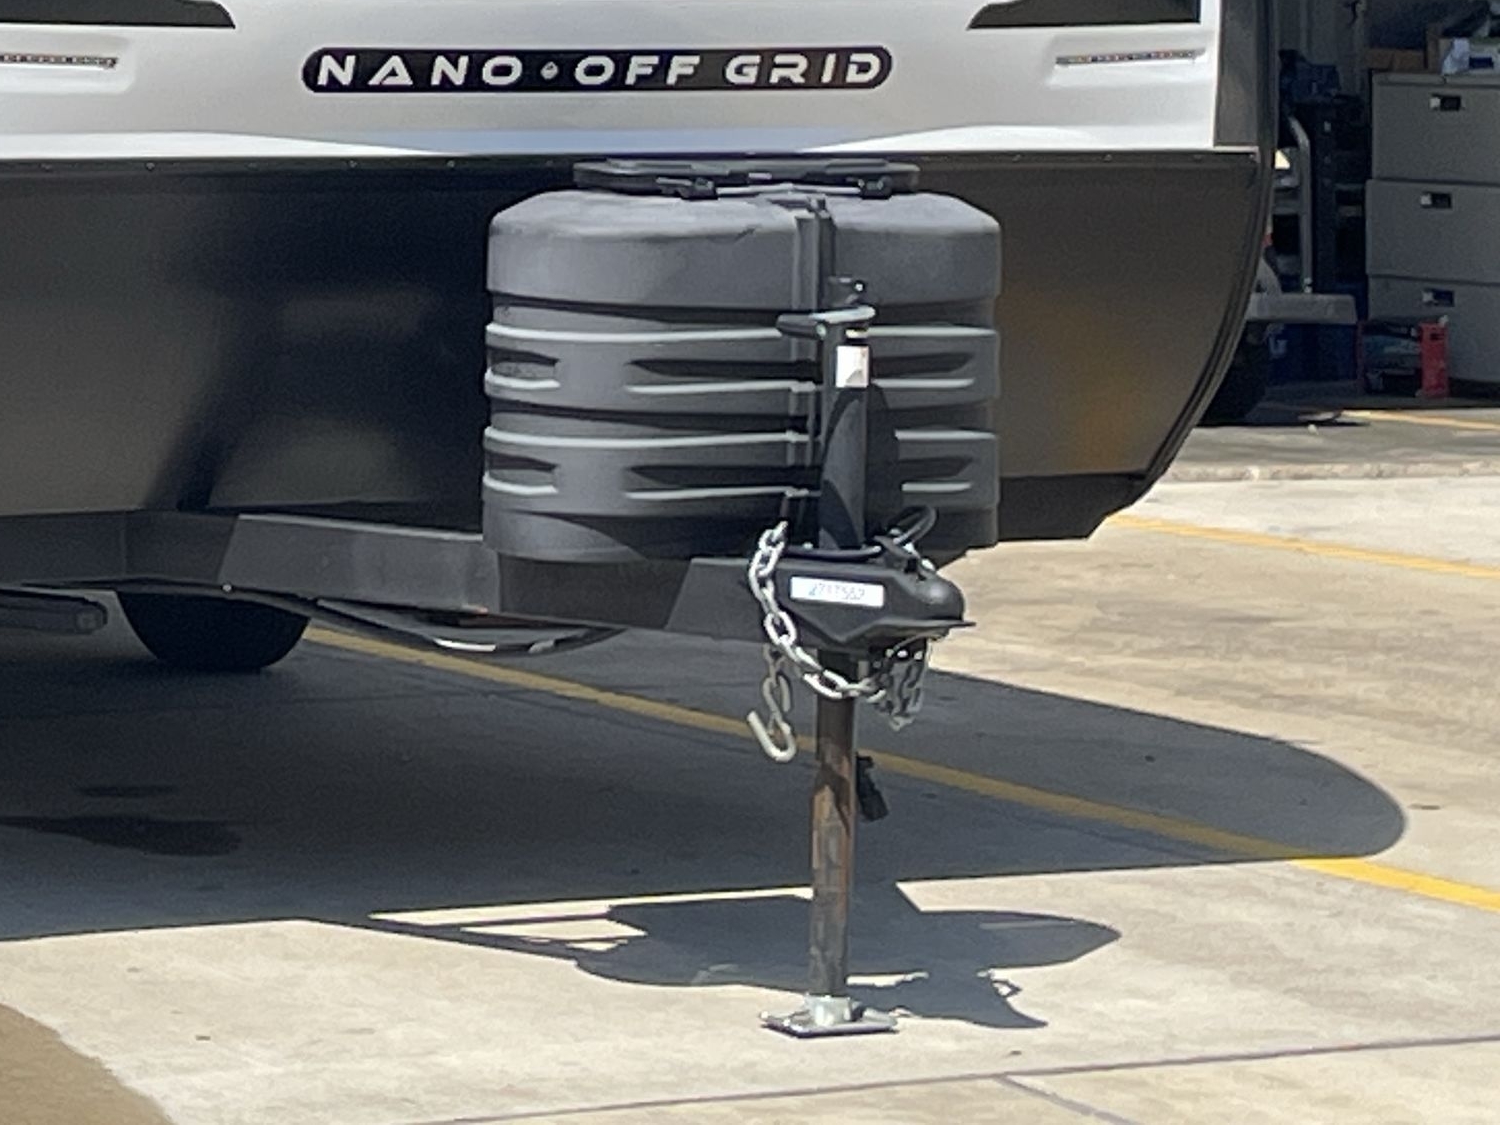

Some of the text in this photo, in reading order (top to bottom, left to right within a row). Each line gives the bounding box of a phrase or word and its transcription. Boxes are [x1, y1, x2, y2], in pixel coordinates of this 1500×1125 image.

[316, 52, 884, 86] NANO OFF GRID
